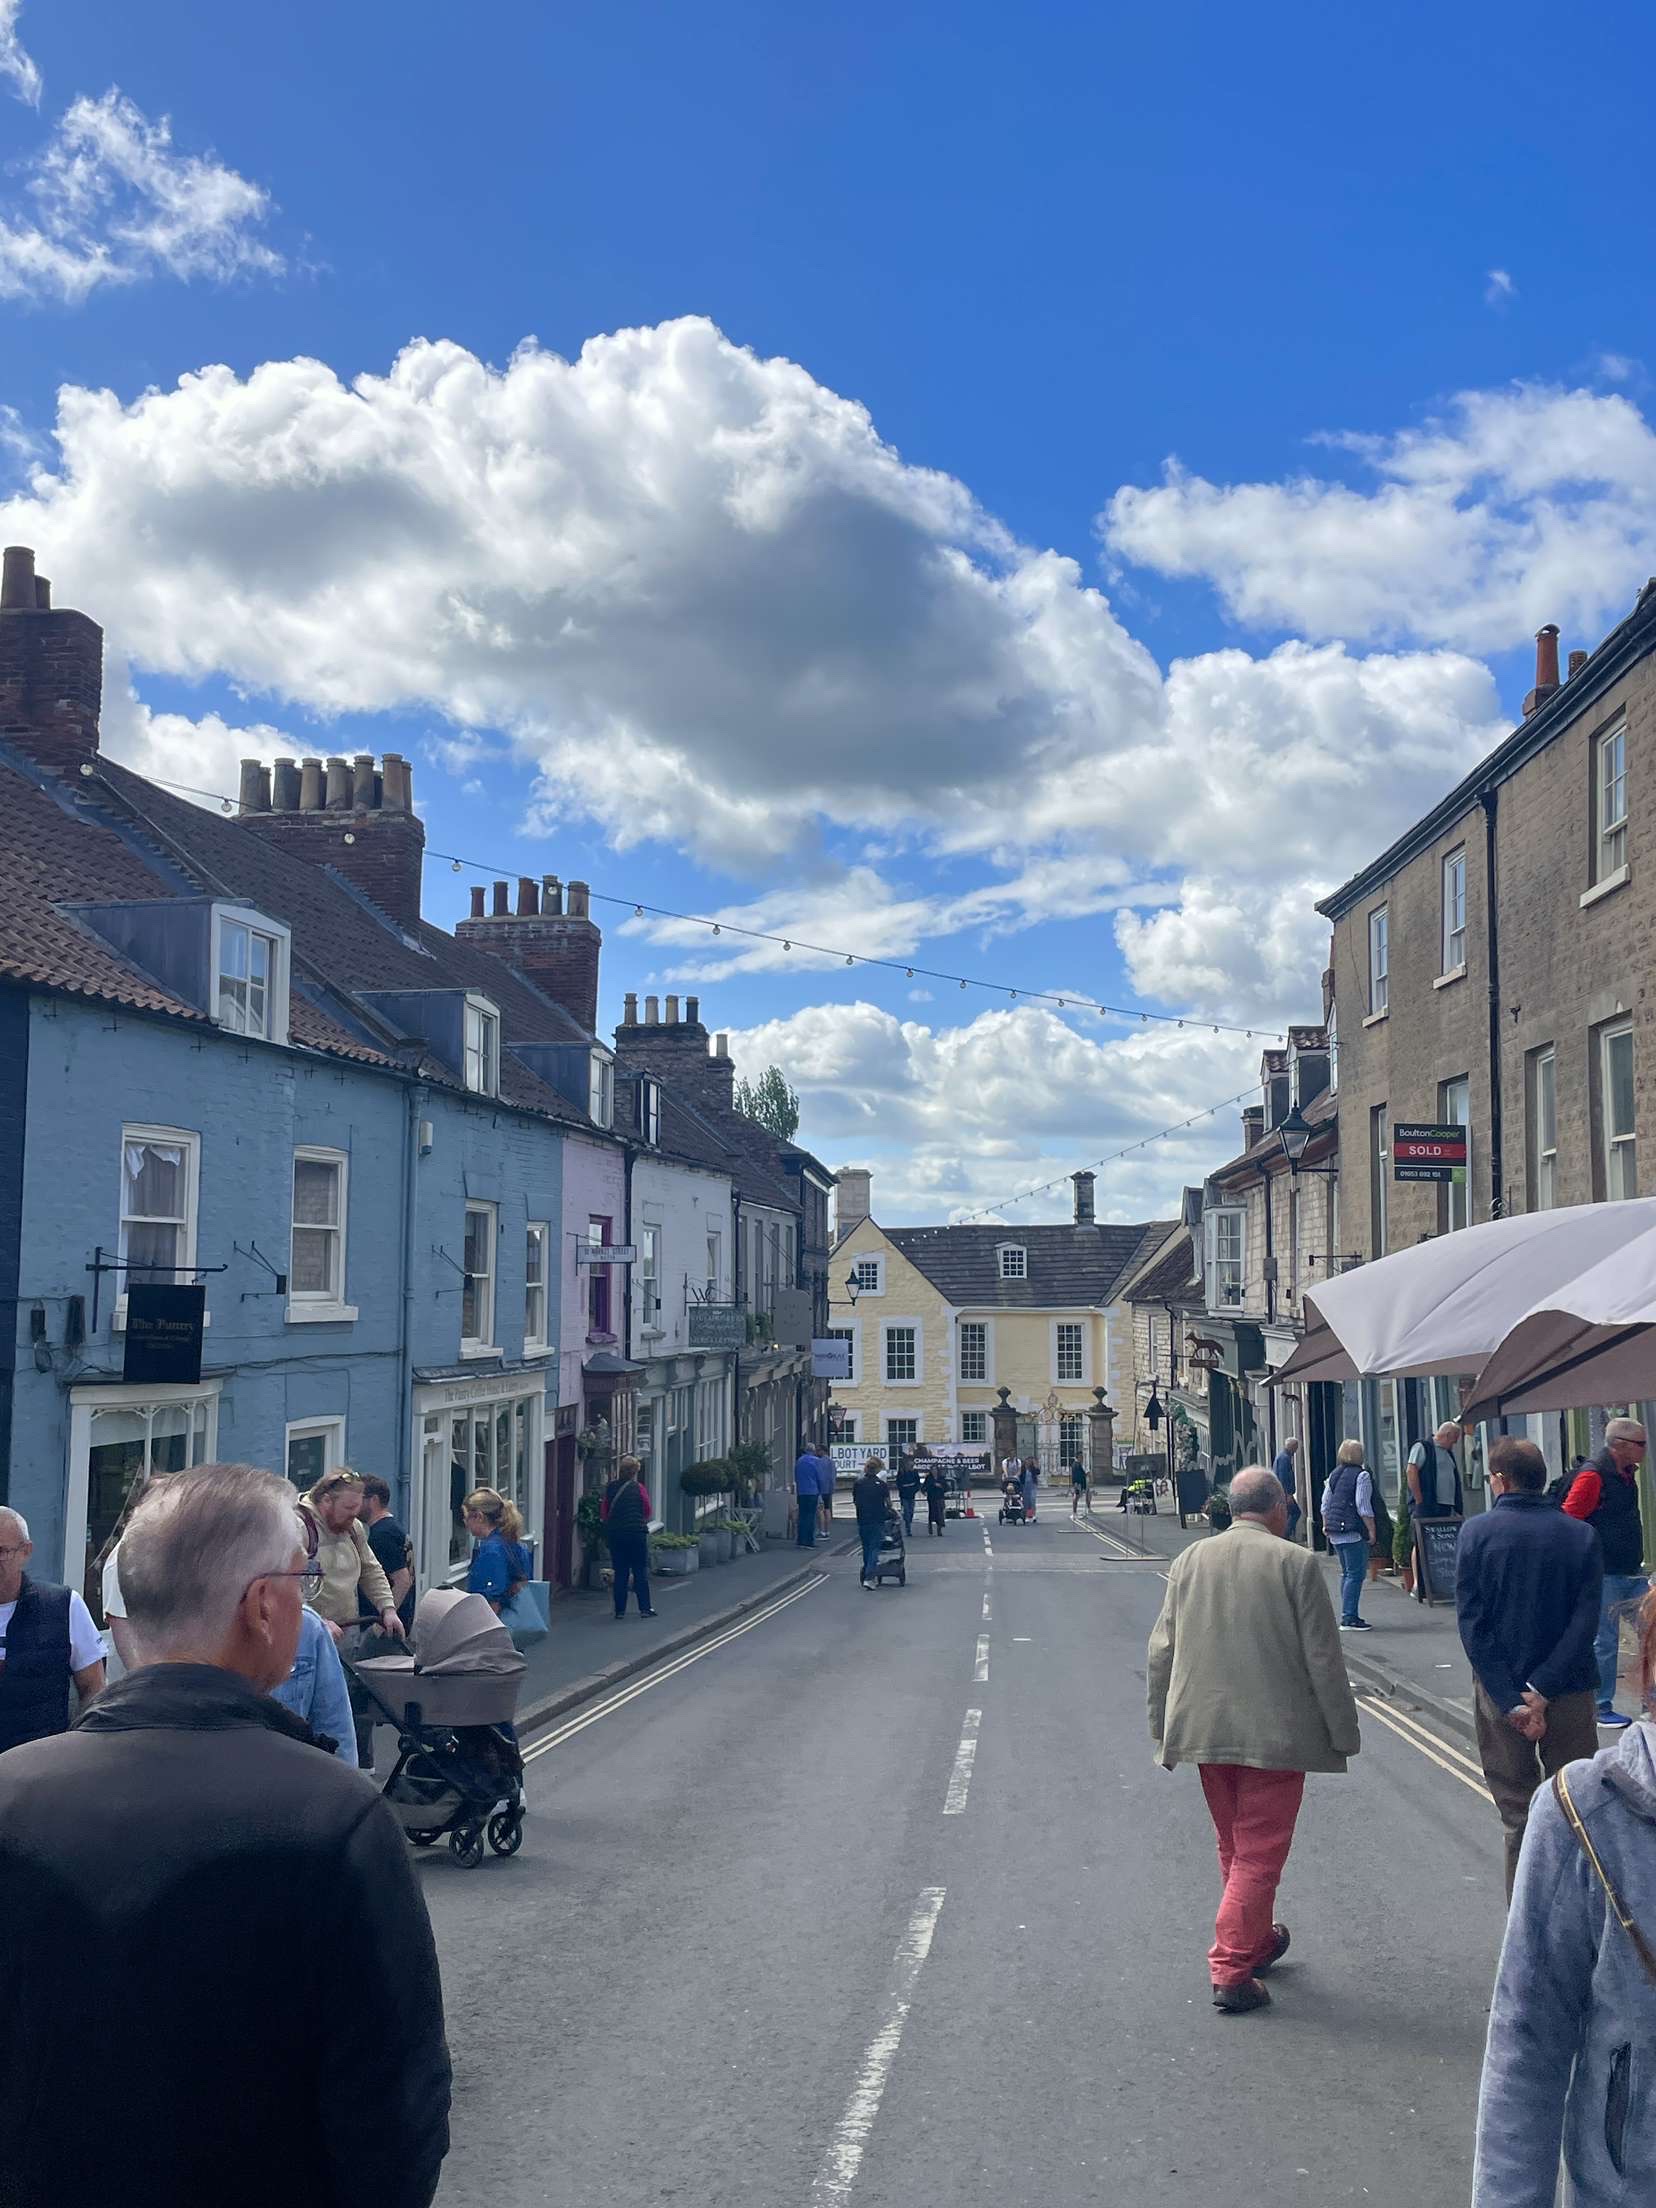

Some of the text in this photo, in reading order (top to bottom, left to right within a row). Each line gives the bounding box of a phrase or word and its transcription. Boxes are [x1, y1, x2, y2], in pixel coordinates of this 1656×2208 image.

[1399, 1129, 1460, 1139] BoultonCooper
[1409, 1146, 1441, 1155] SOLD
[831, 1447, 887, 1459] LBOT YARD
[834, 1460, 857, 1470] OURT
